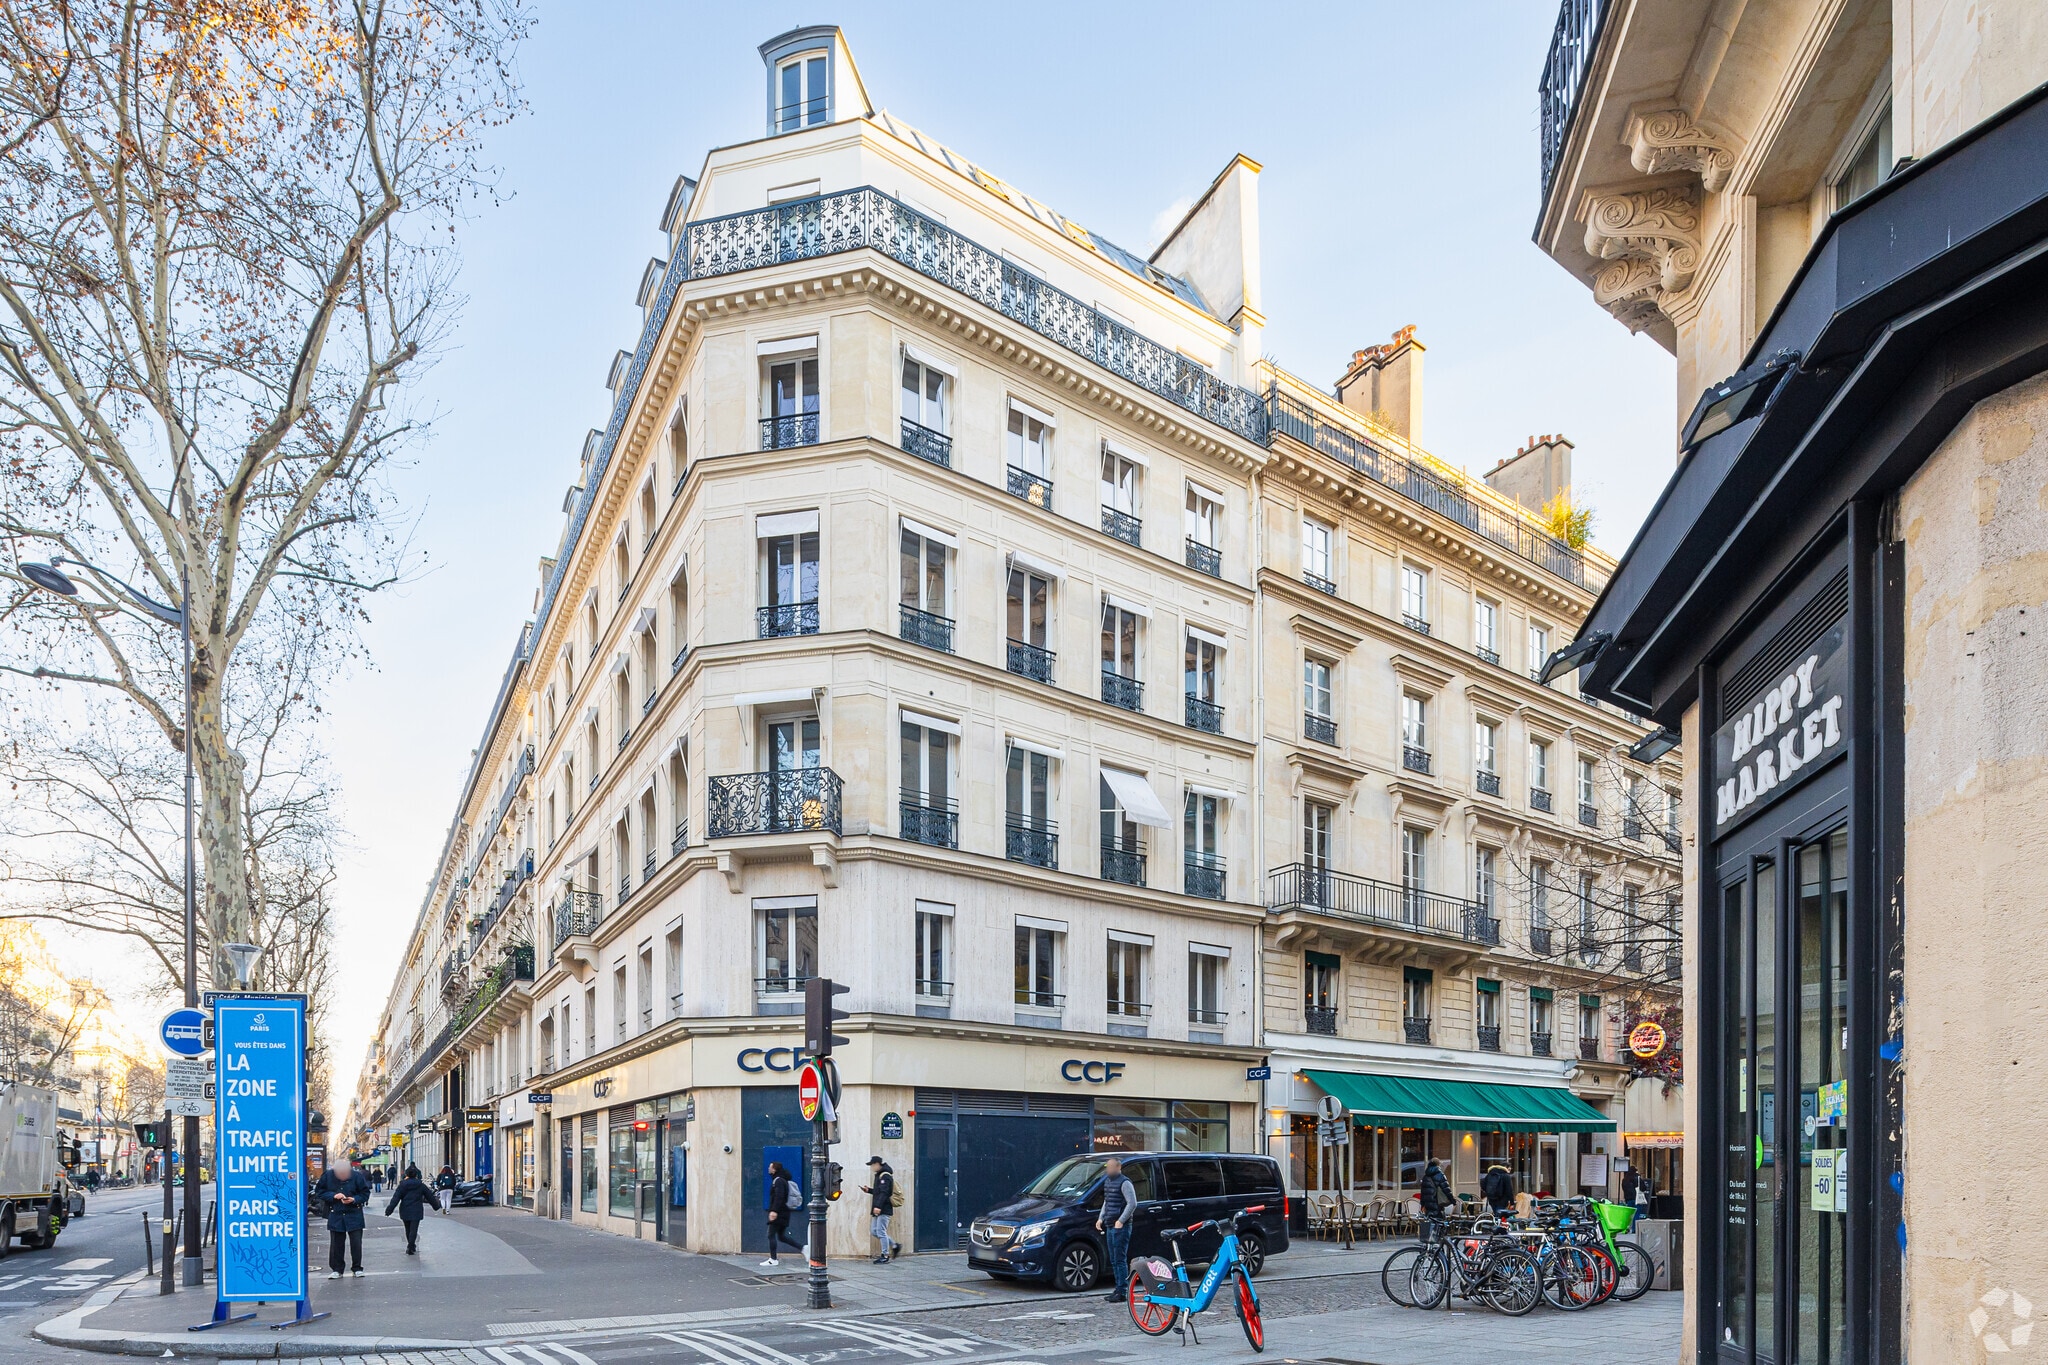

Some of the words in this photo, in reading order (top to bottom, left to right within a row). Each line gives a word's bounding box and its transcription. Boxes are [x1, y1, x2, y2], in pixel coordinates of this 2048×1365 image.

[1732, 654, 1818, 762] HIPPY
[1716, 694, 1842, 825] MARKET
[253, 1041, 268, 1049] ÊTES
[227, 1053, 251, 1071] LA
[1061, 1059, 1126, 1084] CCF
[1249, 1069, 1267, 1078] CCF
[226, 1079, 277, 1097] ZONE
[227, 1101, 241, 1122] À
[227, 1130, 293, 1148] TRAFIC
[228, 1151, 289, 1173] LIMITÉ
[1815, 1157, 1833, 1168] SOLDES
[229, 1199, 279, 1216] PARIS
[229, 1221, 294, 1238] CENTRE
[1202, 1269, 1218, 1294] dott
